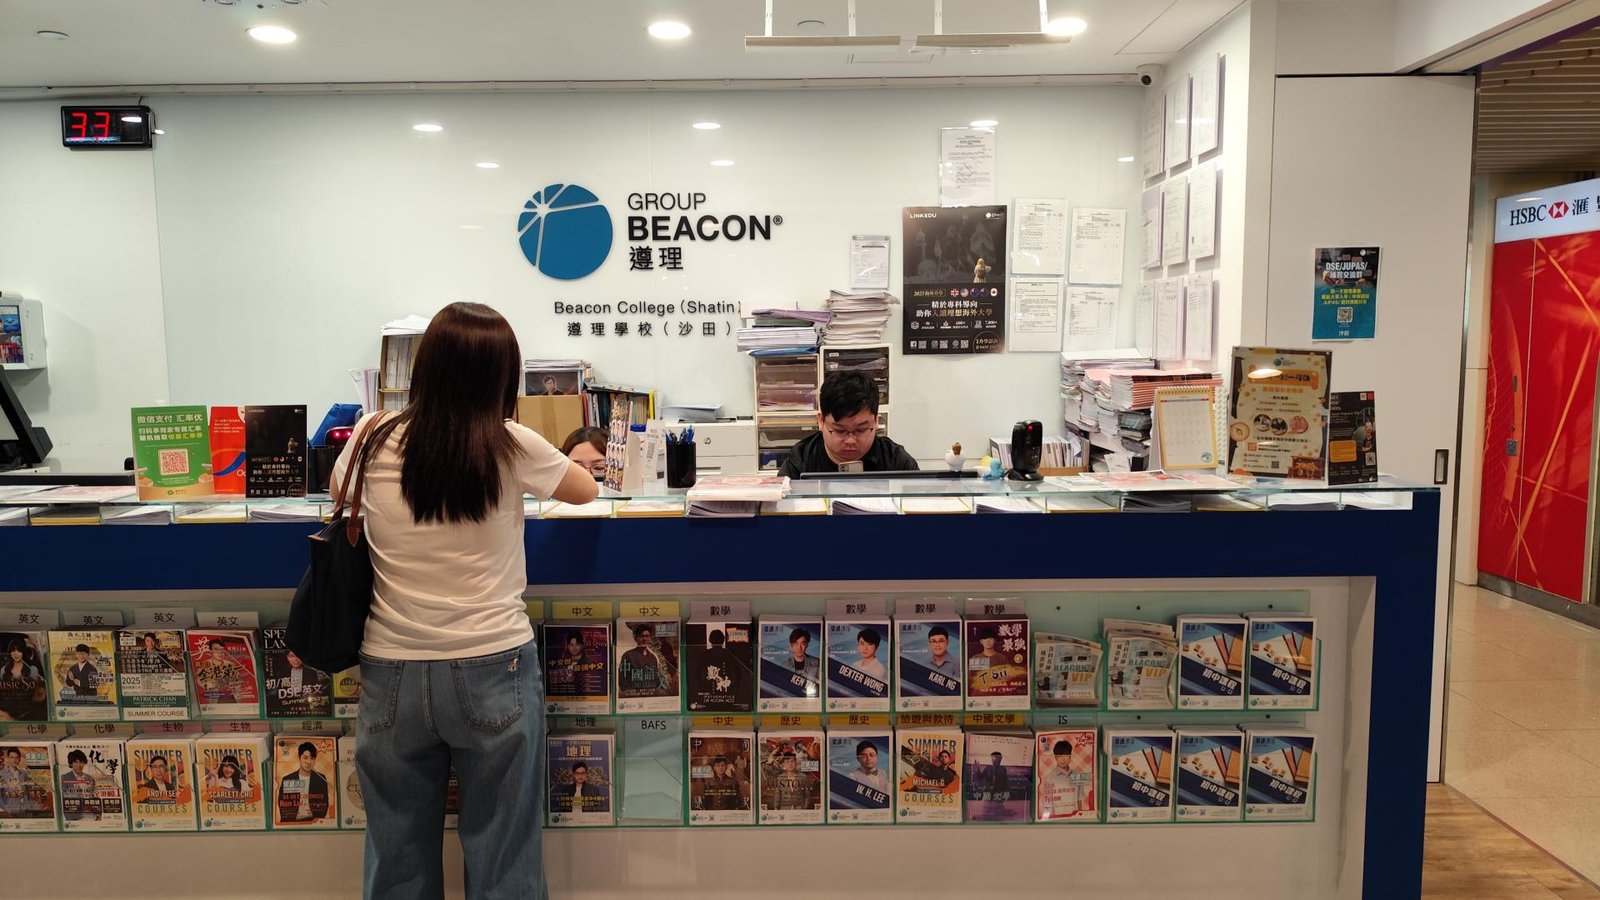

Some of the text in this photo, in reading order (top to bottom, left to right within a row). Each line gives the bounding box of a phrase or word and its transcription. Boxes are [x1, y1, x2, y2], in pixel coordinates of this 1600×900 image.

[71, 112, 110, 140] 33
[627, 192, 707, 210] GROUP
[1509, 195, 1600, 226] HSBC 滙
[629, 246, 684, 271] 遵理
[1325, 262, 1368, 271] DSE/JUPAS/
[554, 301, 611, 314] Beacon
[617, 301, 675, 317] College
[567, 321, 731, 337] 遵理學校（沙田）
[137, 414, 173, 424] 微信支付
[572, 606, 593, 617] 中文
[639, 606, 660, 617] 中文
[710, 605, 731, 617] 數學
[846, 603, 867, 615] 數學
[915, 603, 936, 615] 數學
[984, 604, 1006, 614] 數學
[19, 613, 40, 625] 英文
[83, 615, 104, 625] 英文
[154, 612, 176, 623] 英文
[217, 616, 240, 626] 英文
[1072, 672, 1093, 682] VIP
[1145, 667, 1166, 678] VIP
[121, 676, 141, 685] 2025
[790, 673, 804, 687] KEN
[838, 665, 884, 693] DEXTER WONG
[928, 671, 957, 690] KARL NG
[1202, 668, 1238, 690] 初中課程
[1271, 667, 1308, 690] 初中課程
[575, 717, 597, 727] 地理
[713, 716, 734, 726] 中史
[780, 715, 801, 725] 歷史
[848, 715, 870, 725] 歷史
[972, 714, 1016, 724] 中國文學
[1057, 715, 1068, 725] IS
[27, 723, 48, 734] 化學
[94, 723, 116, 734] 化學
[163, 722, 184, 733] 生物
[229, 722, 250, 732] 生物
[302, 720, 323, 731] 經濟
[641, 720, 667, 730] BAFS
[907, 738, 957, 752] SUMMER
[566, 745, 593, 757] 地理
[165, 789, 177, 798] TSE
[208, 790, 240, 799] SCARLETT
[1131, 780, 1166, 801] 初中課程
[1200, 779, 1236, 801] 初中課程
[872, 792, 887, 804] LEE
[904, 793, 954, 804] COURSES
[137, 804, 188, 814] COURSES
[207, 803, 258, 813] COURSES
